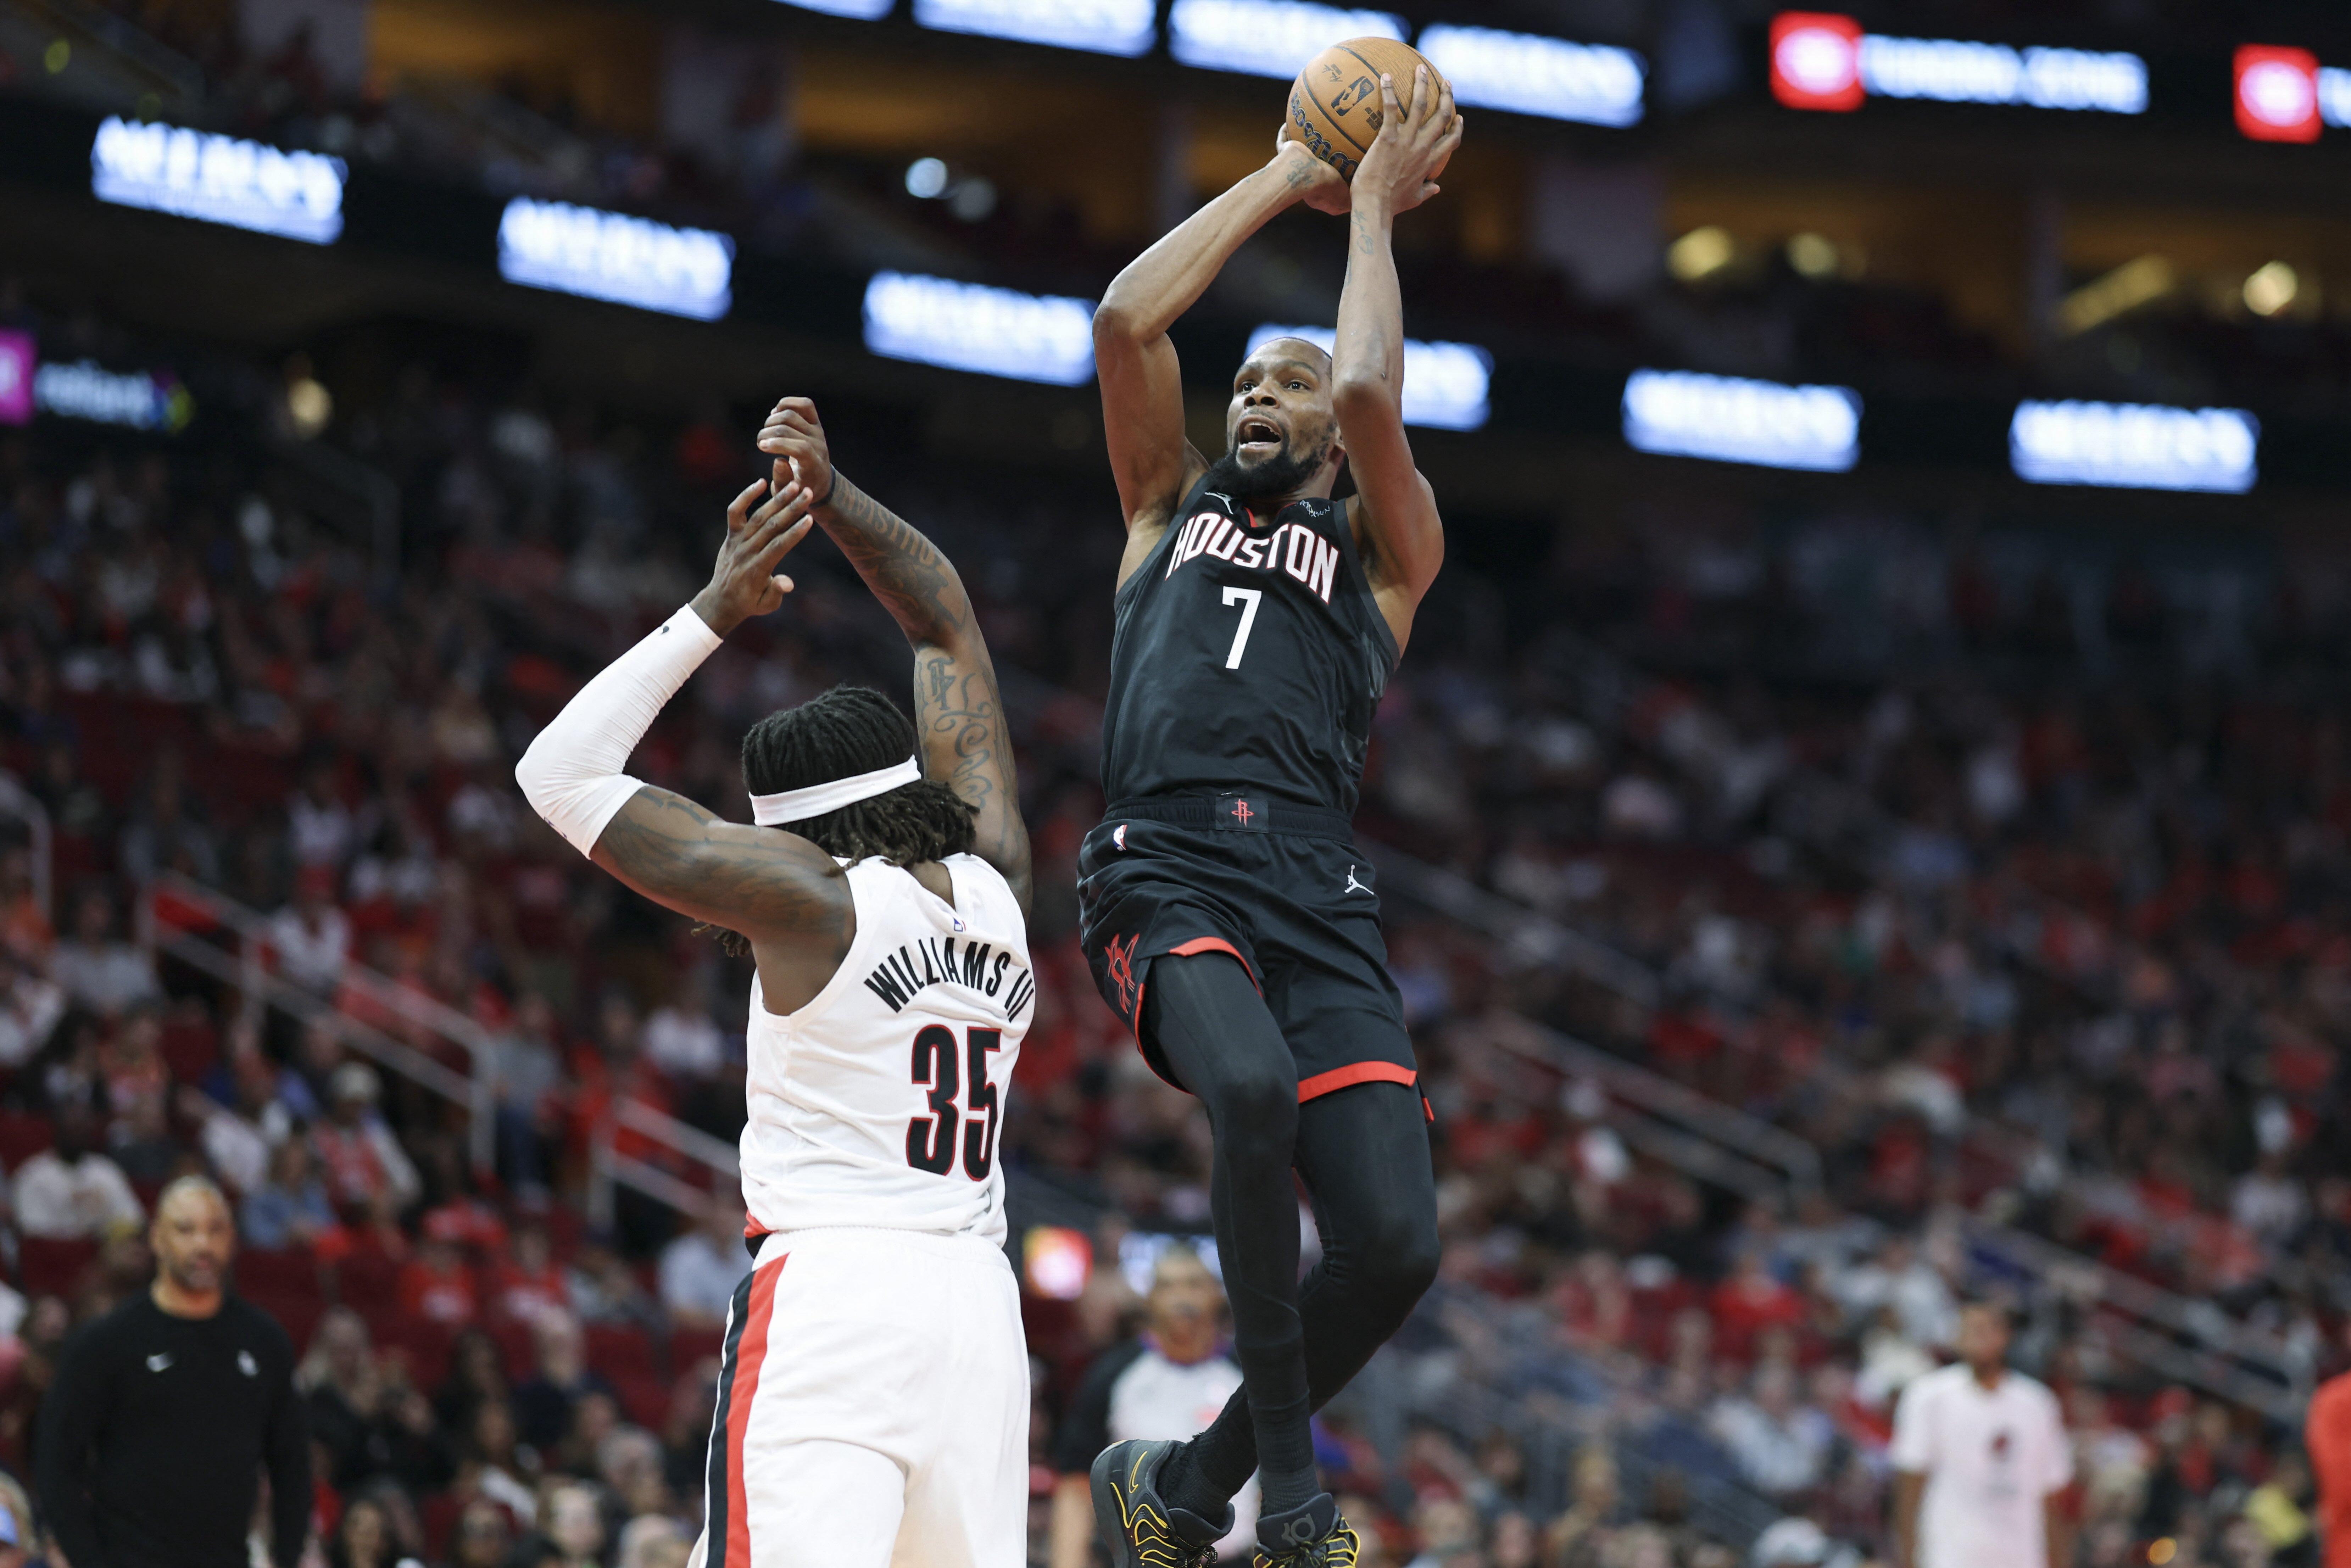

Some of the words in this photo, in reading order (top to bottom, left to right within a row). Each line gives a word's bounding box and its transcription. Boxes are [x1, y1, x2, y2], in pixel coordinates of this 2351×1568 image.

[1165, 512, 1340, 604] HOUSTON
[1222, 586, 1262, 669] 7
[864, 937, 1010, 1013] WILLIAMS
[906, 1024, 1002, 1182] 35
